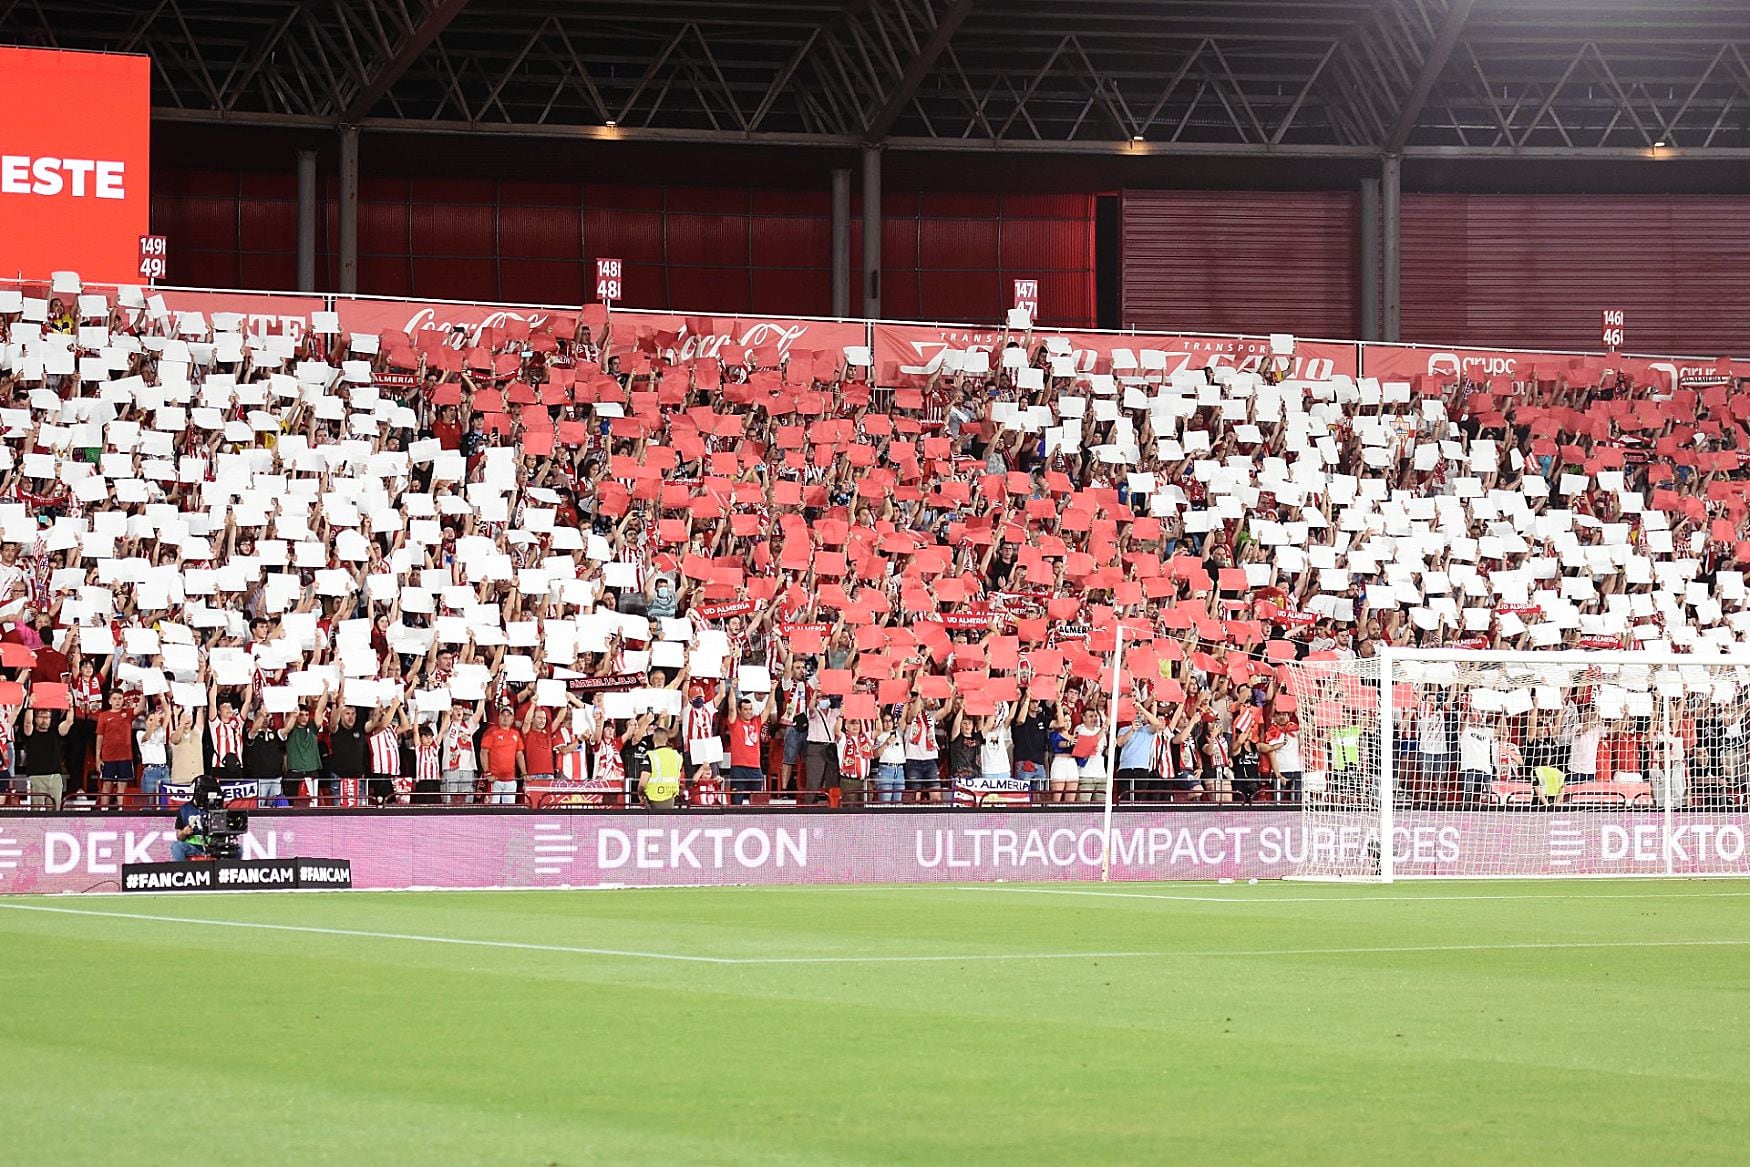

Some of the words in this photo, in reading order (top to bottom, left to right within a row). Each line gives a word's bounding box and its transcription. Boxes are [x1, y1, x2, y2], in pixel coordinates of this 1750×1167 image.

[2, 155, 125, 199] ESTE
[940, 332, 1048, 345] TRANSPORT
[1184, 341, 1267, 354] TRANSPOR
[45, 830, 277, 874] DEKN
[598, 827, 808, 869] DEKTON
[915, 826, 1251, 868] ULTRACOMPACT
[126, 870, 211, 889] #FANCAM
[218, 867, 294, 884] #FANCAM
[300, 866, 350, 883] #FANCAM
